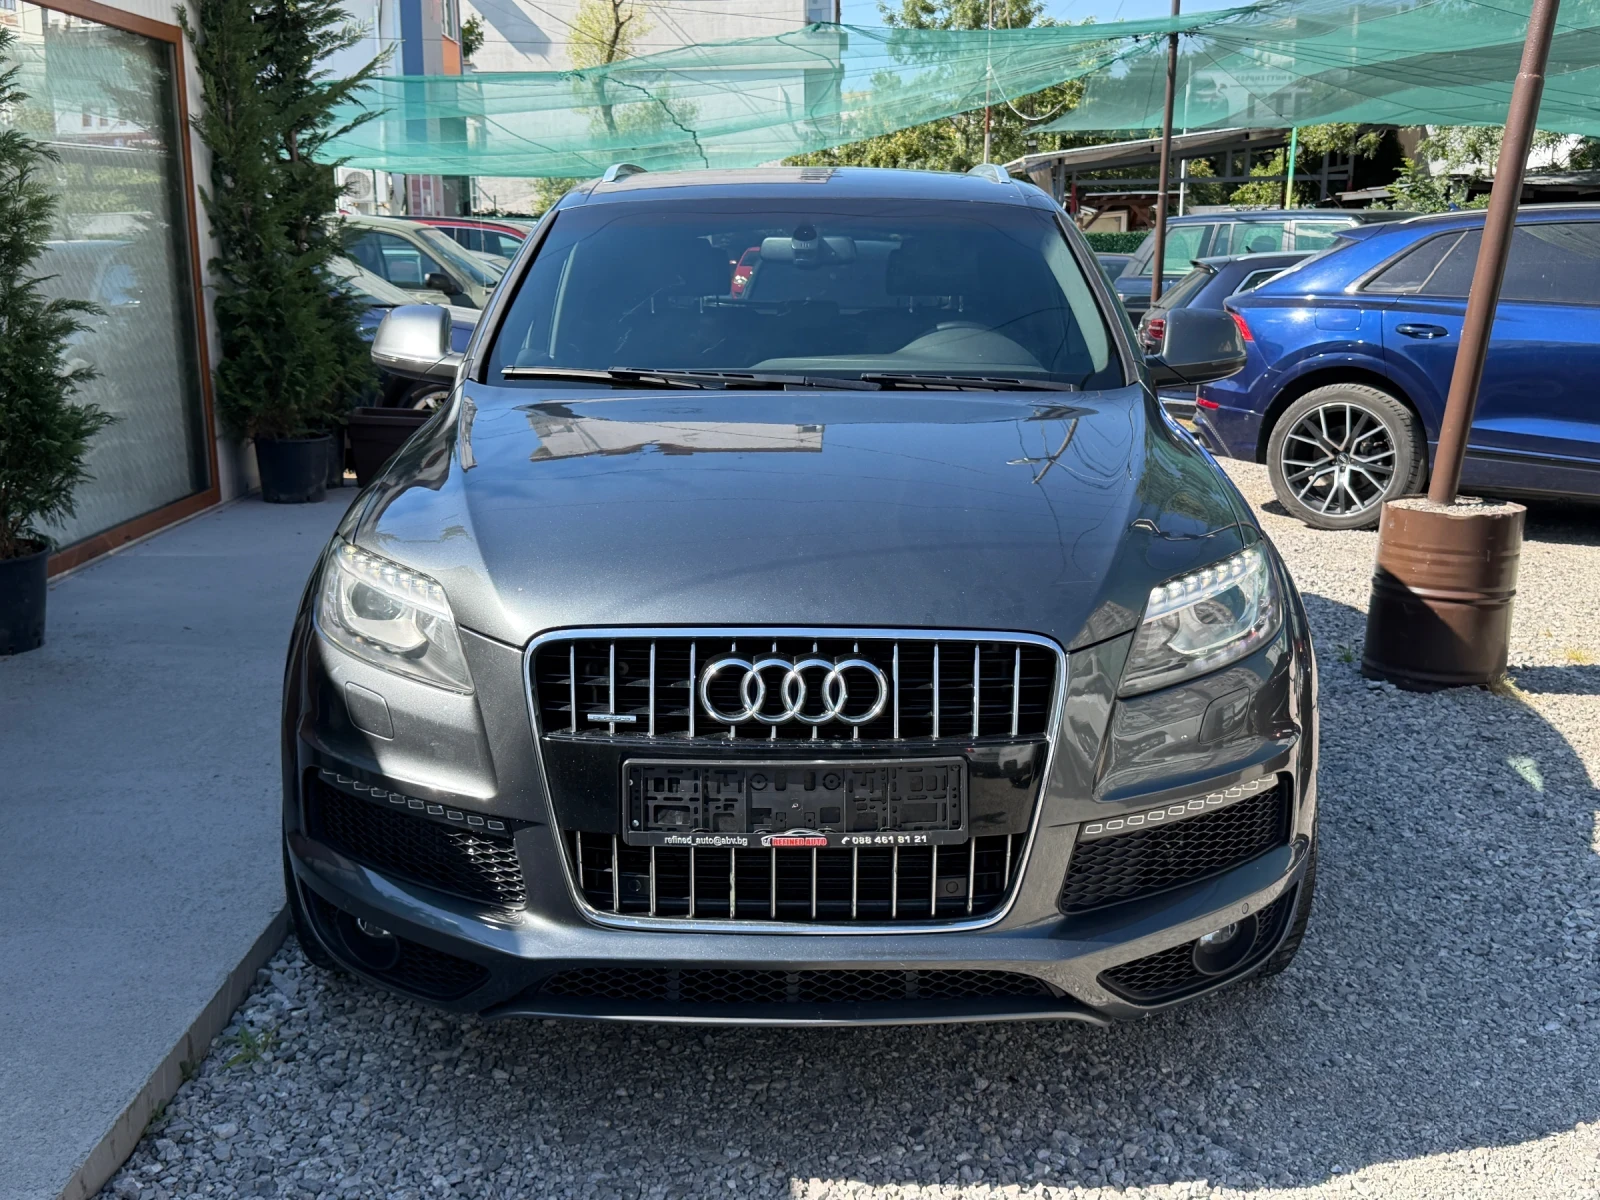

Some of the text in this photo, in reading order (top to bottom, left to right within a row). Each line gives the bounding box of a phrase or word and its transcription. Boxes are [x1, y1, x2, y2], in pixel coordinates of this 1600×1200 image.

[664, 835, 748, 847] refined_auto@abv.bg
[772, 838, 827, 846] REFINED AUTO
[852, 834, 927, 845] 088 461 81 21
